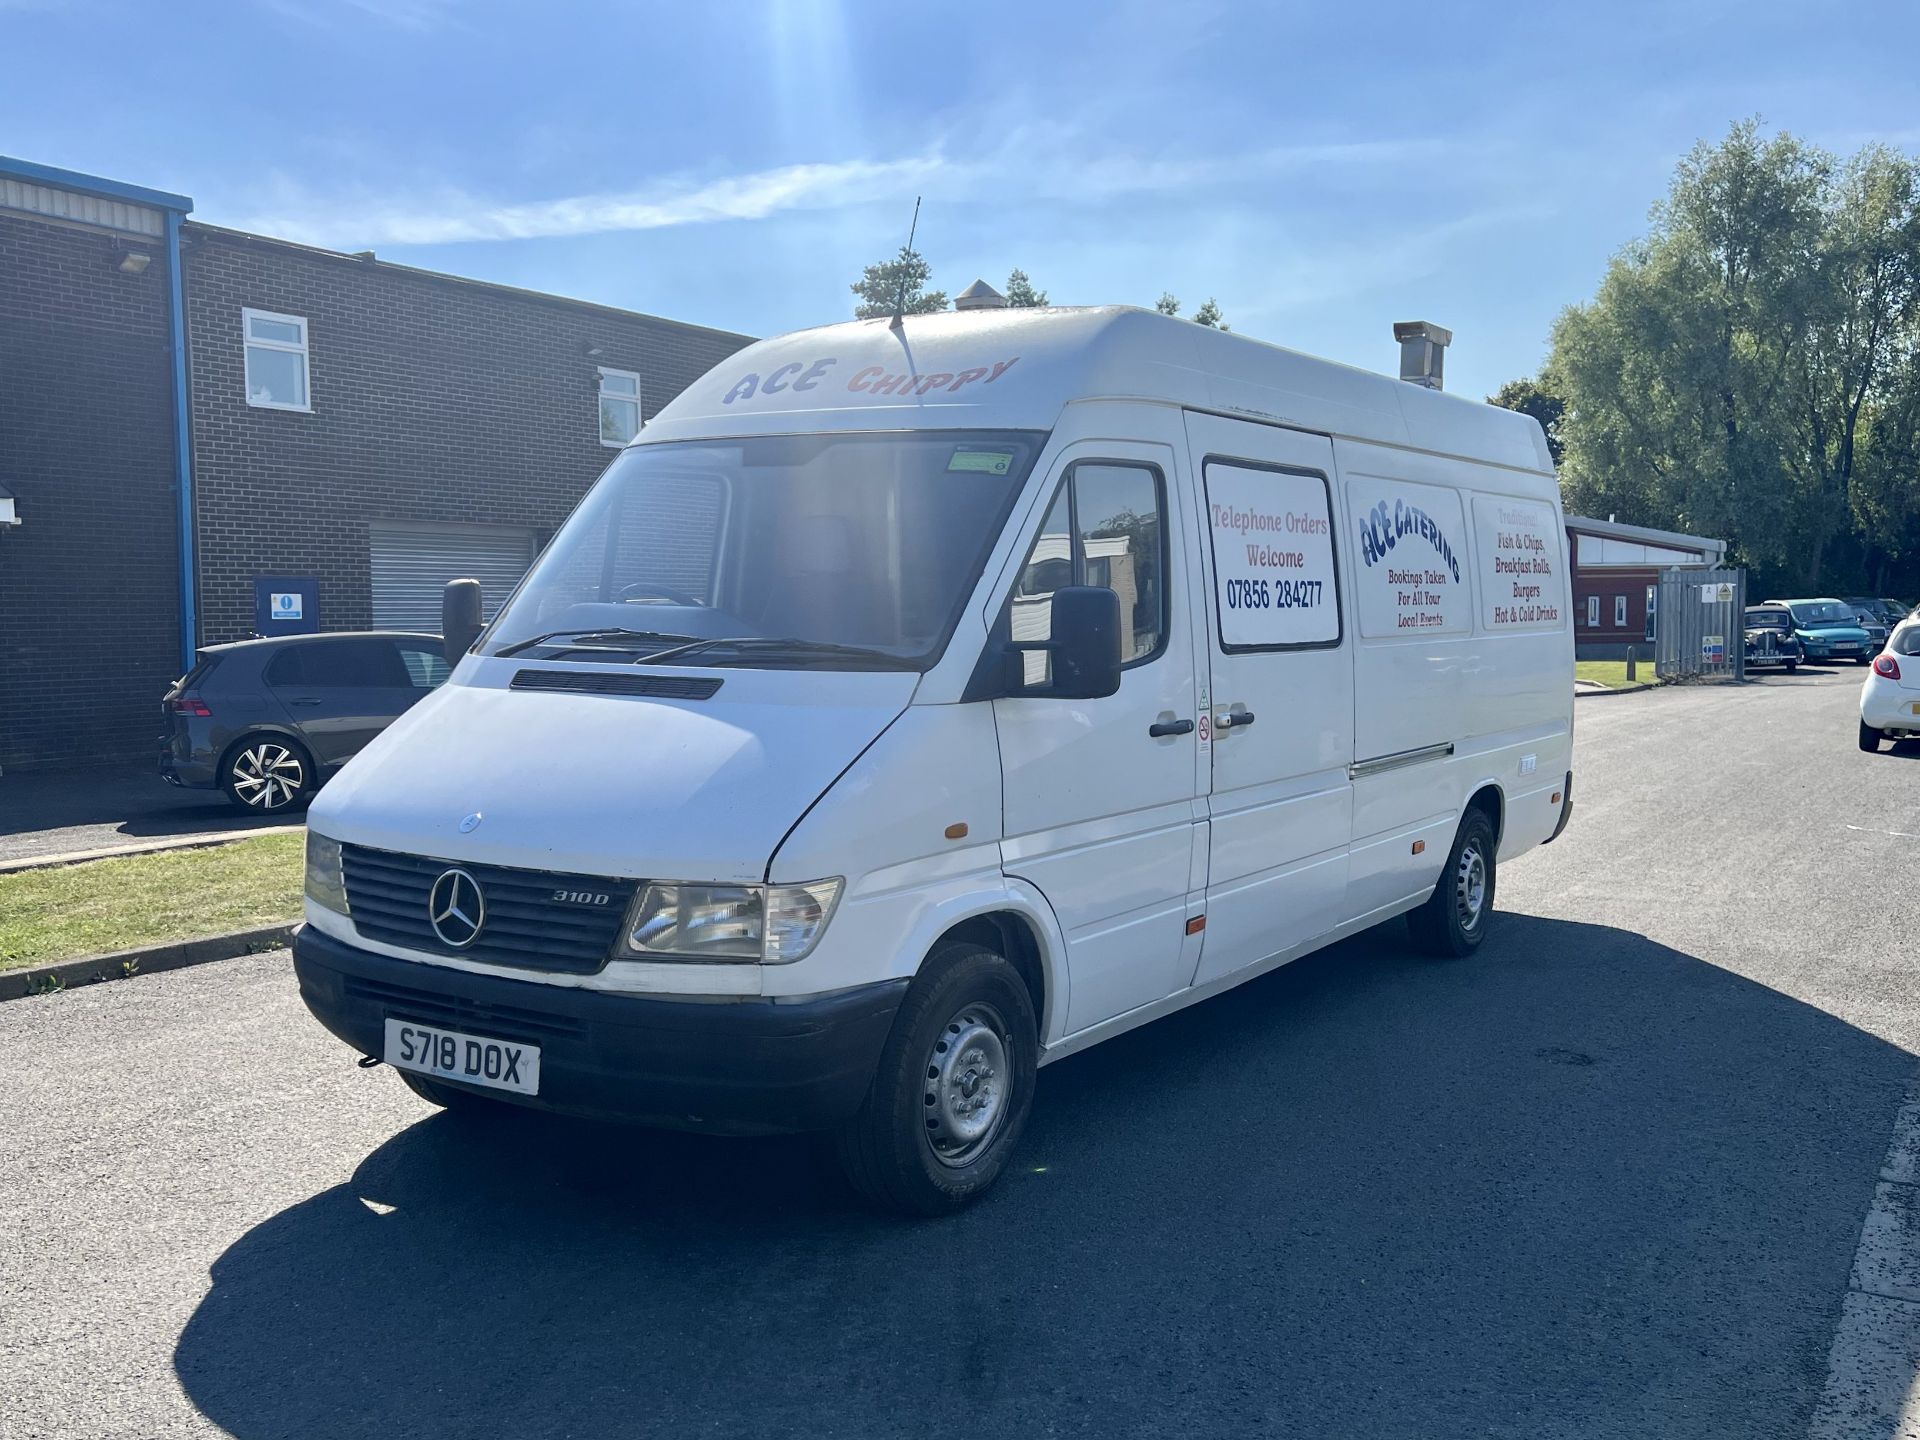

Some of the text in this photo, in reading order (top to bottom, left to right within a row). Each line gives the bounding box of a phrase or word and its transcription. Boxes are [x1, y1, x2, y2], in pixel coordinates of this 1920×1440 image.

[722, 358, 837, 404] ACE
[1211, 504, 1327, 535] Telephone Orders
[1359, 498, 1460, 584] ACE CATERING
[1497, 532, 1514, 549] Fish
[1515, 534, 1523, 549] &
[1246, 544, 1304, 568] Welcome
[1495, 557, 1552, 578] Breakfast Rolls,
[1388, 569, 1446, 588] Bookings Taken
[1227, 579, 1322, 609] 07856 284277
[1398, 591, 1441, 606] For All Your
[1513, 582, 1540, 602] Burgers
[1398, 613, 1419, 627] Local
[1494, 605, 1557, 624] Hot & Cold Drinks
[400, 1027, 522, 1084] S718 DOX
